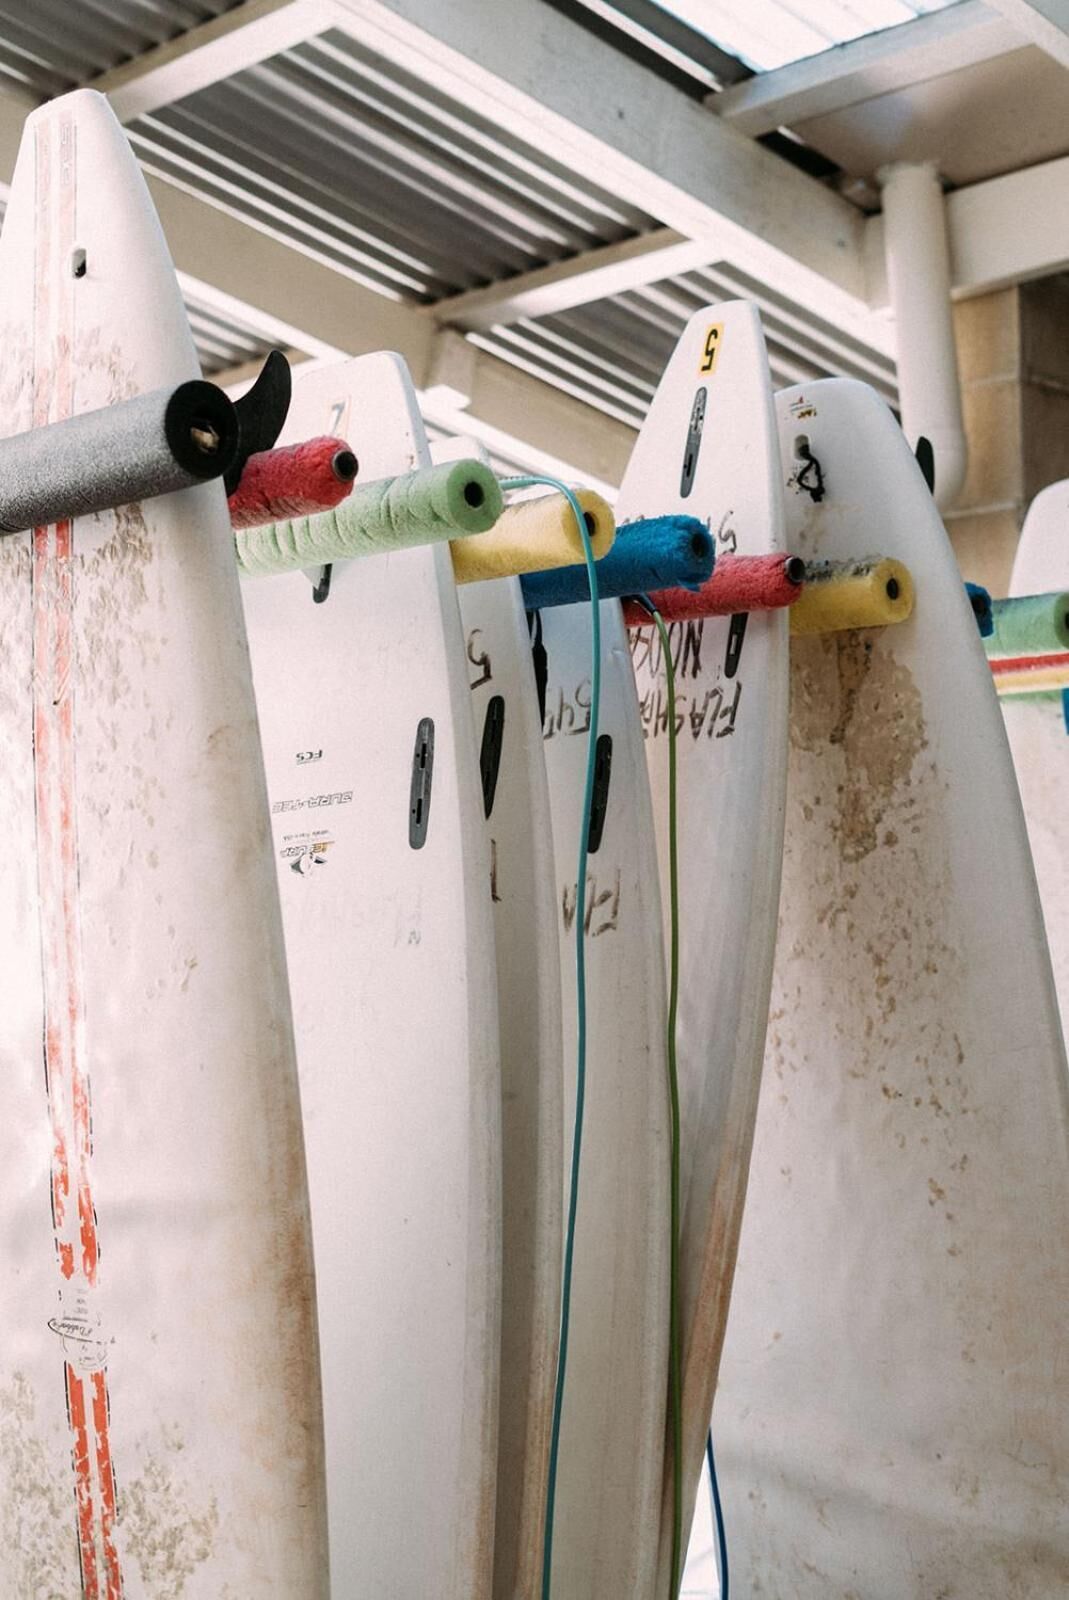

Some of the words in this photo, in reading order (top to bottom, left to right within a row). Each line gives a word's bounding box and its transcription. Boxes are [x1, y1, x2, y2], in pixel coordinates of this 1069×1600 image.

[701, 329, 718, 372] 5
[466, 629, 492, 691] 5
[296, 749, 323, 761] FCS
